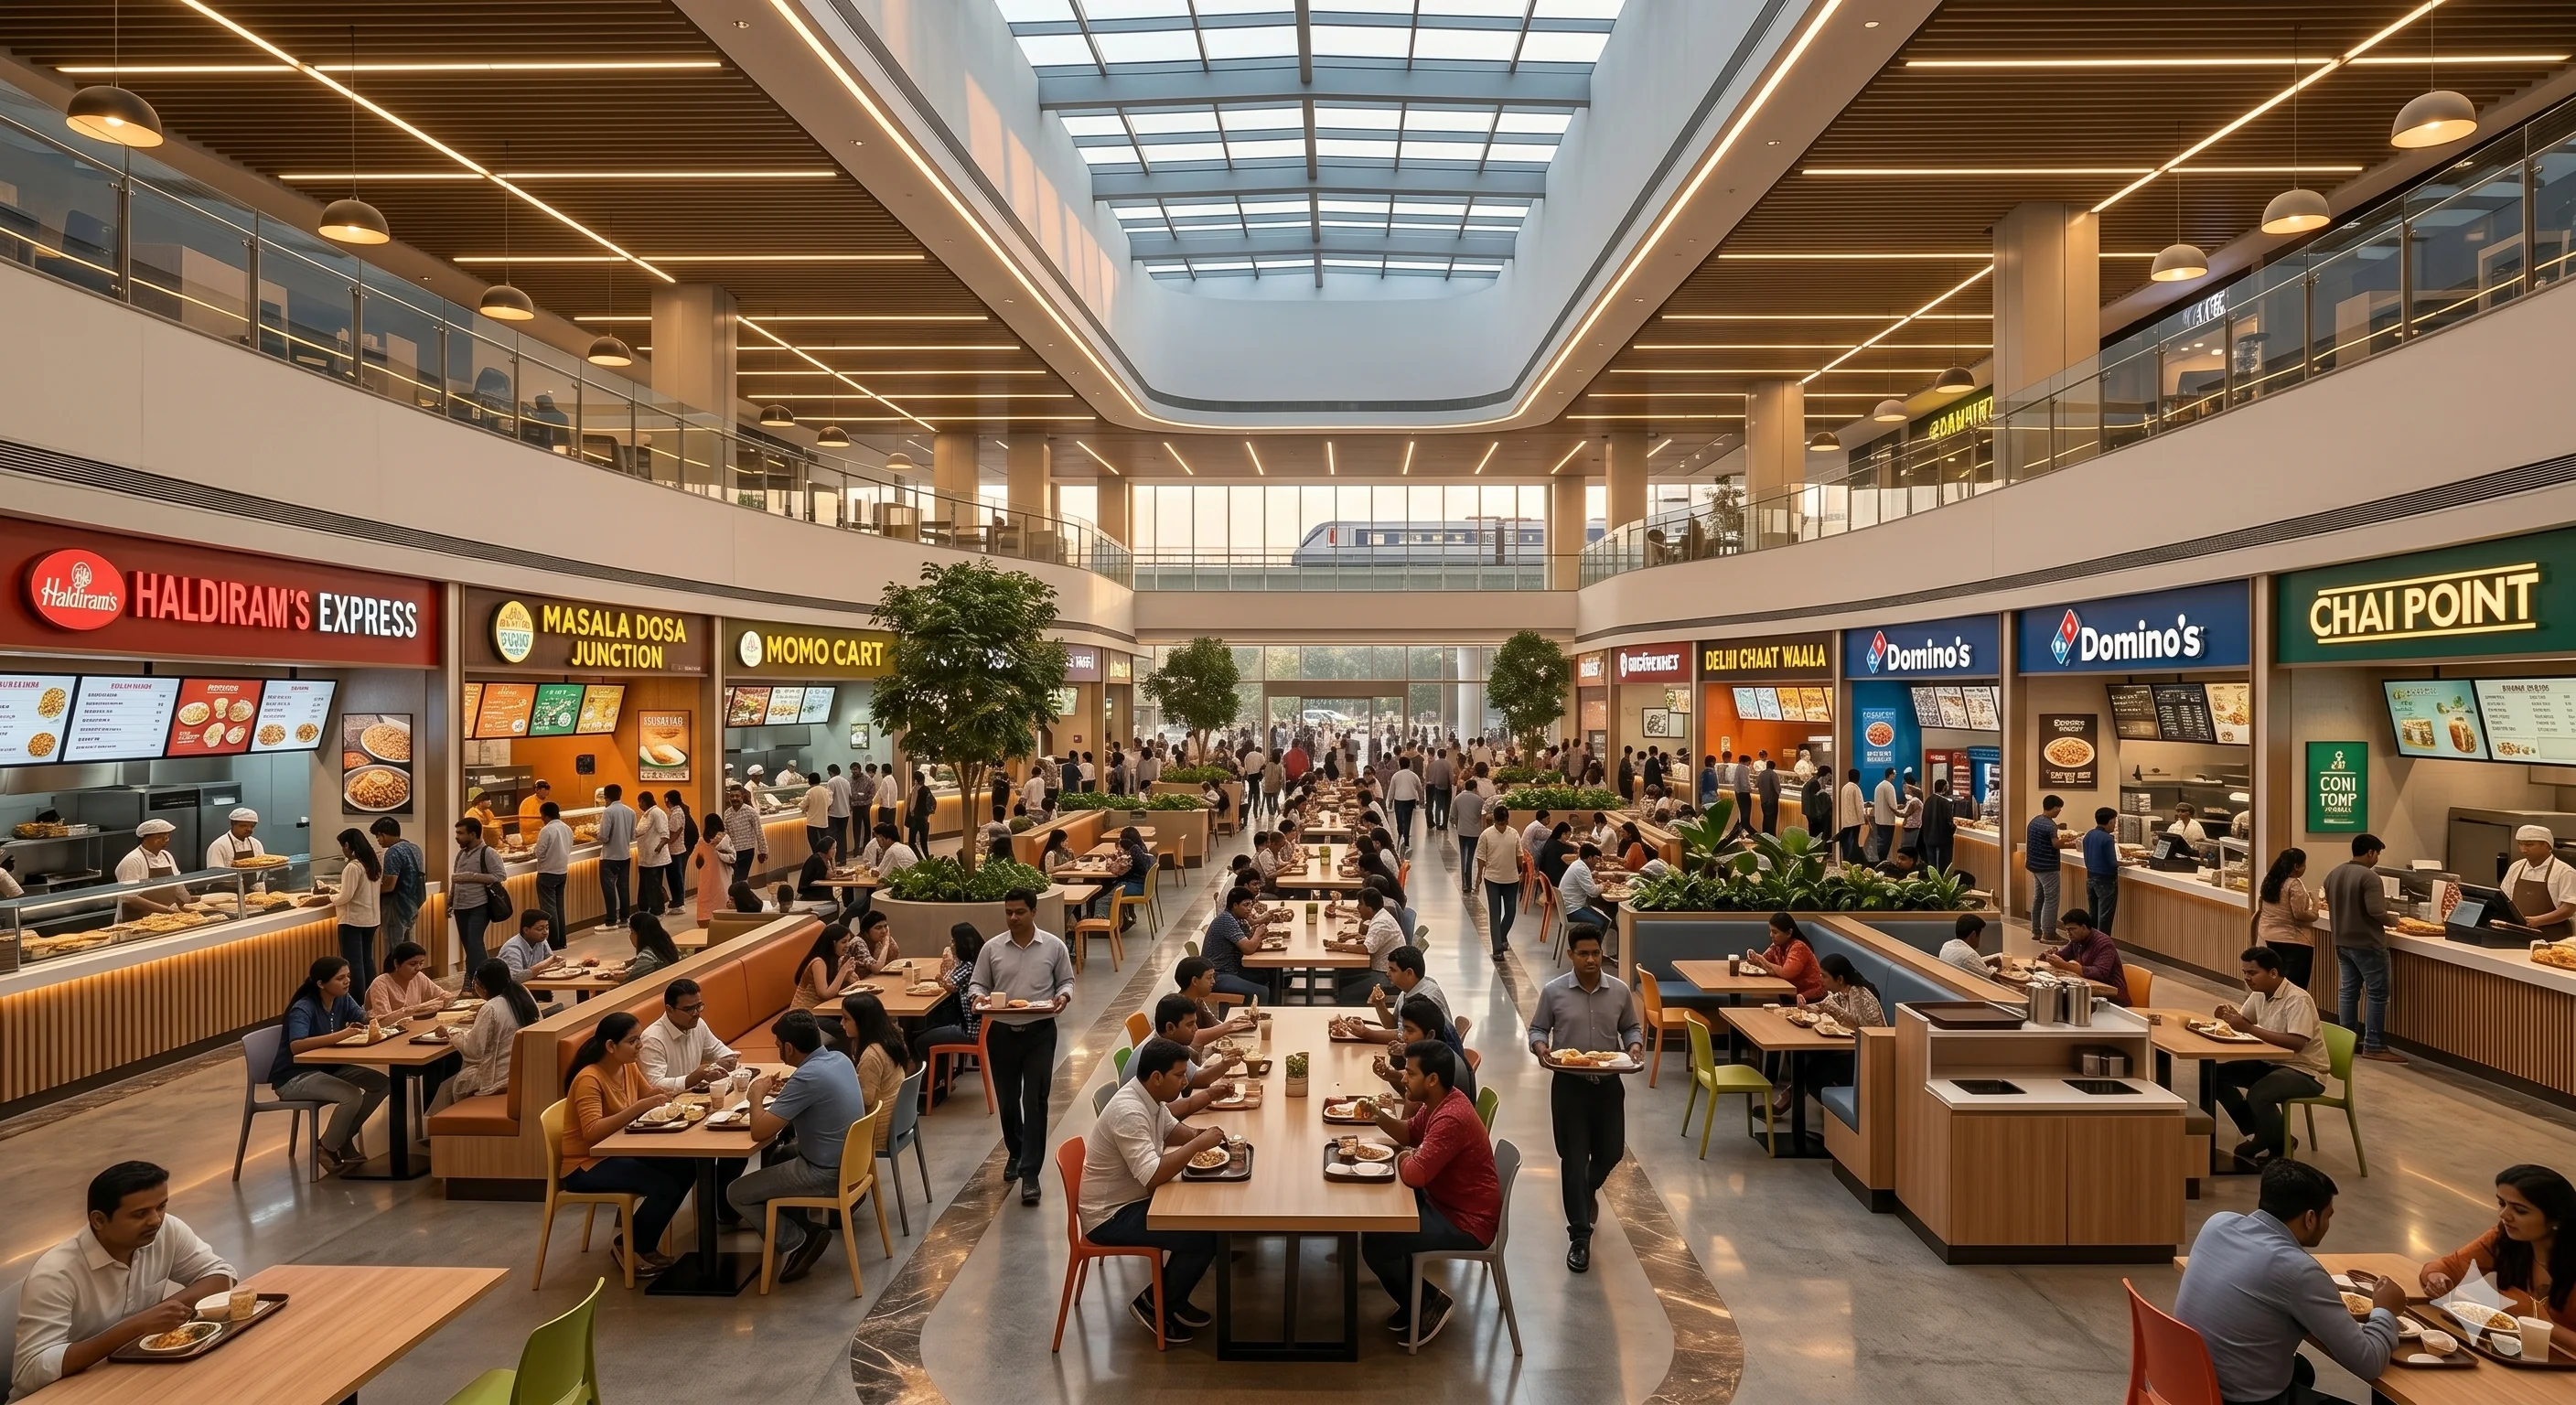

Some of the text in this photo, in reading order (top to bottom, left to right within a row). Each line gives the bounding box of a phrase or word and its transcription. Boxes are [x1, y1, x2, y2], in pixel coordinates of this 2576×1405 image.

[40, 575, 118, 612] Haldiram's
[136, 571, 417, 638] HALDIRAM'S EXPRESS
[2310, 572, 2539, 638] CHAI POINT
[543, 605, 631, 638] MASALA
[636, 614, 687, 643] DOSA
[2081, 614, 2201, 661] Domino's
[572, 640, 662, 669] JUNCTION
[767, 635, 884, 666] MOMO CART
[1705, 649, 1737, 670] DELHI
[1740, 646, 1779, 670] CHAAT
[1782, 644, 1827, 668] WAALA
[1887, 636, 1971, 671] Domino's
[2320, 777, 2356, 791] CONI
[2320, 793, 2357, 807] TOMP
